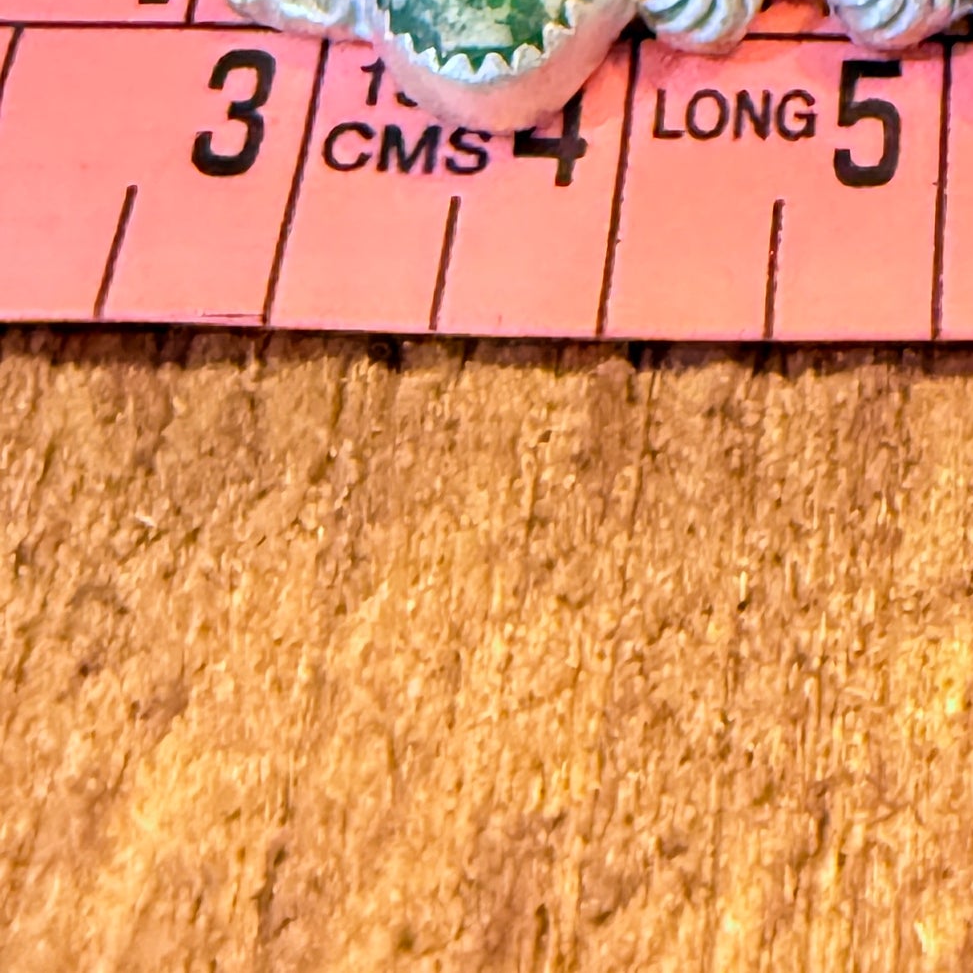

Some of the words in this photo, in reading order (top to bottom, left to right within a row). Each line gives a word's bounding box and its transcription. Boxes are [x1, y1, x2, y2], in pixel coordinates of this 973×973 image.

[190, 48, 277, 177] 3
[321, 121, 492, 176] CMS
[512, 84, 589, 187] 4
[652, 88, 818, 141] LONG
[833, 58, 903, 188] 5
